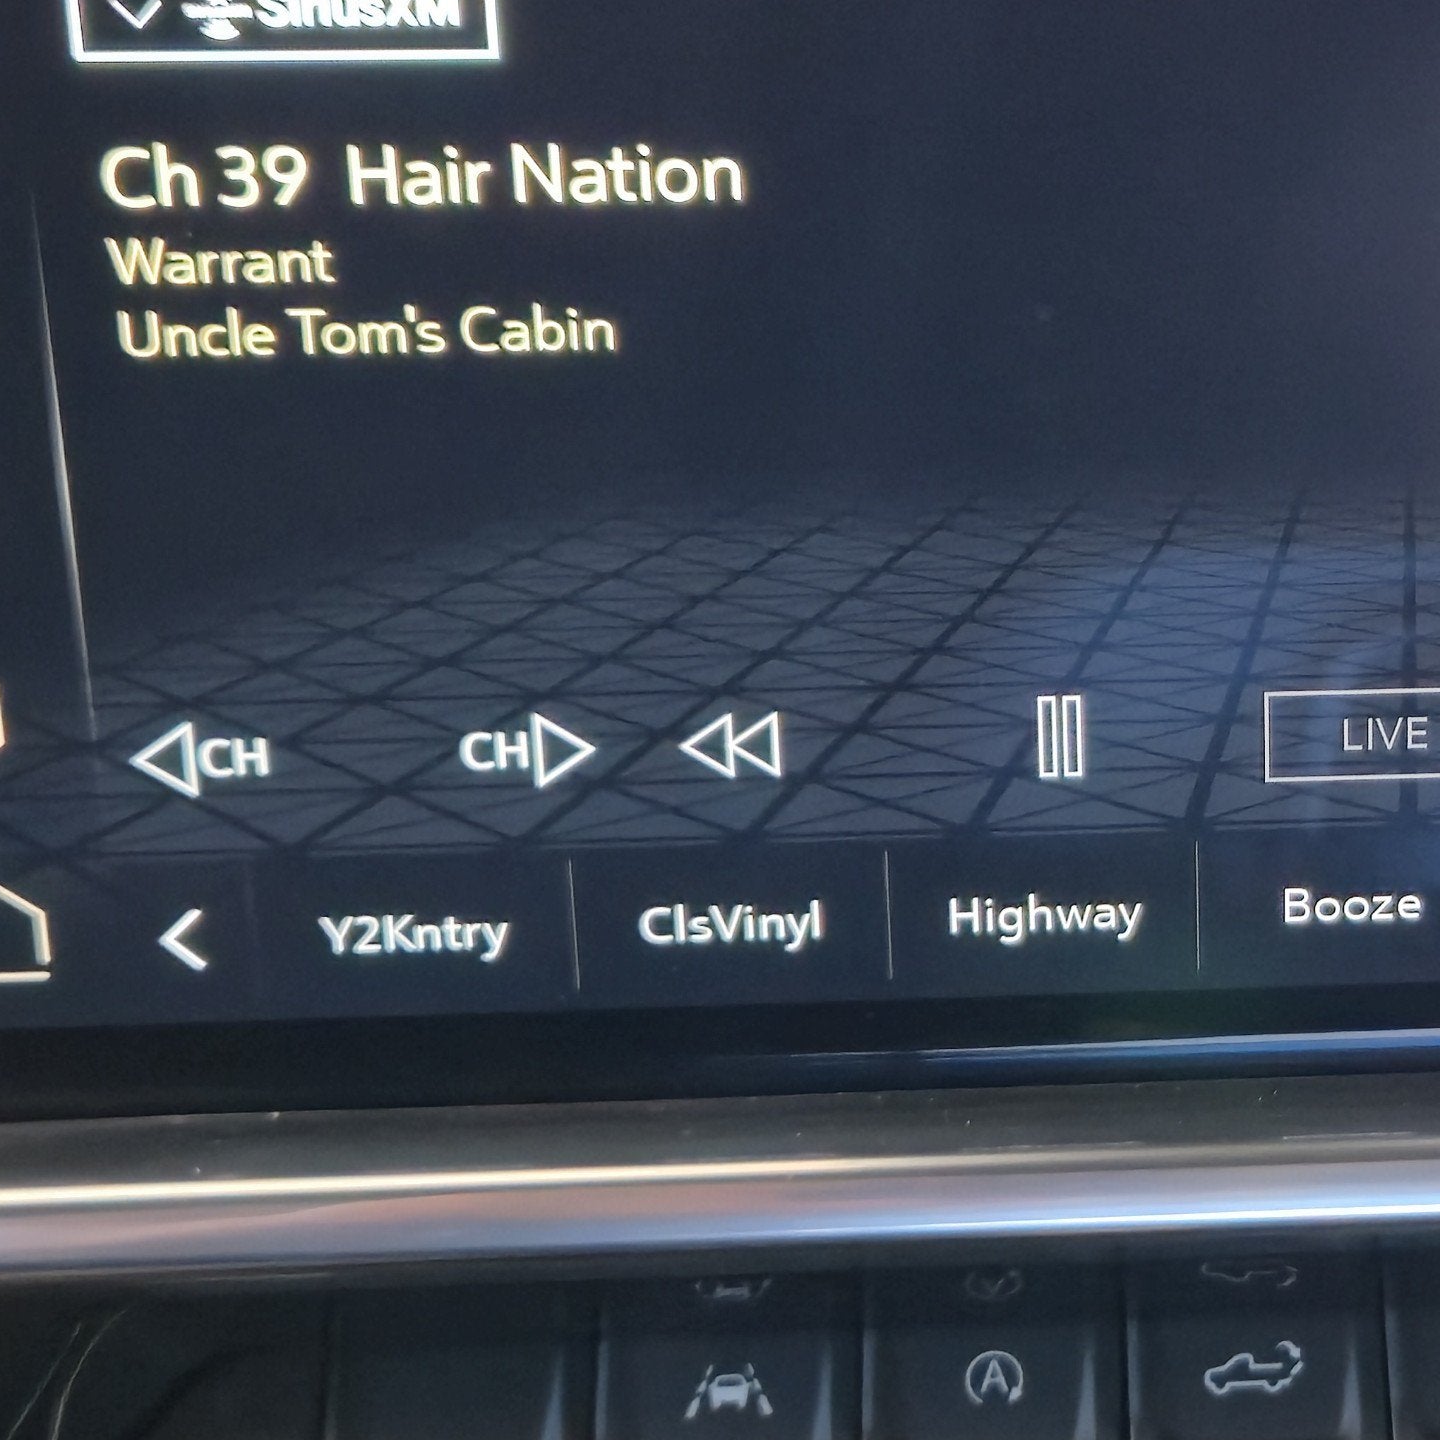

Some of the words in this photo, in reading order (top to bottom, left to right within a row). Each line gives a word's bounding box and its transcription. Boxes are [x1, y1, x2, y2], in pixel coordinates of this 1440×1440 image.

[99, 141, 202, 210] Ch
[215, 144, 310, 210] 39
[345, 143, 494, 208] Hair
[510, 142, 746, 206] Nation
[103, 236, 337, 287] Warrant
[116, 306, 279, 359] Uncle
[284, 303, 449, 356] Tom's
[459, 302, 618, 355] Cabin
[200, 736, 271, 779] CH
[459, 730, 528, 772] CH
[1343, 716, 1430, 753] LIVE
[638, 899, 823, 953] ClsVinyl
[948, 893, 1144, 946] Highway
[1284, 887, 1425, 925] Booze
[317, 914, 509, 963] Y2Kntry
